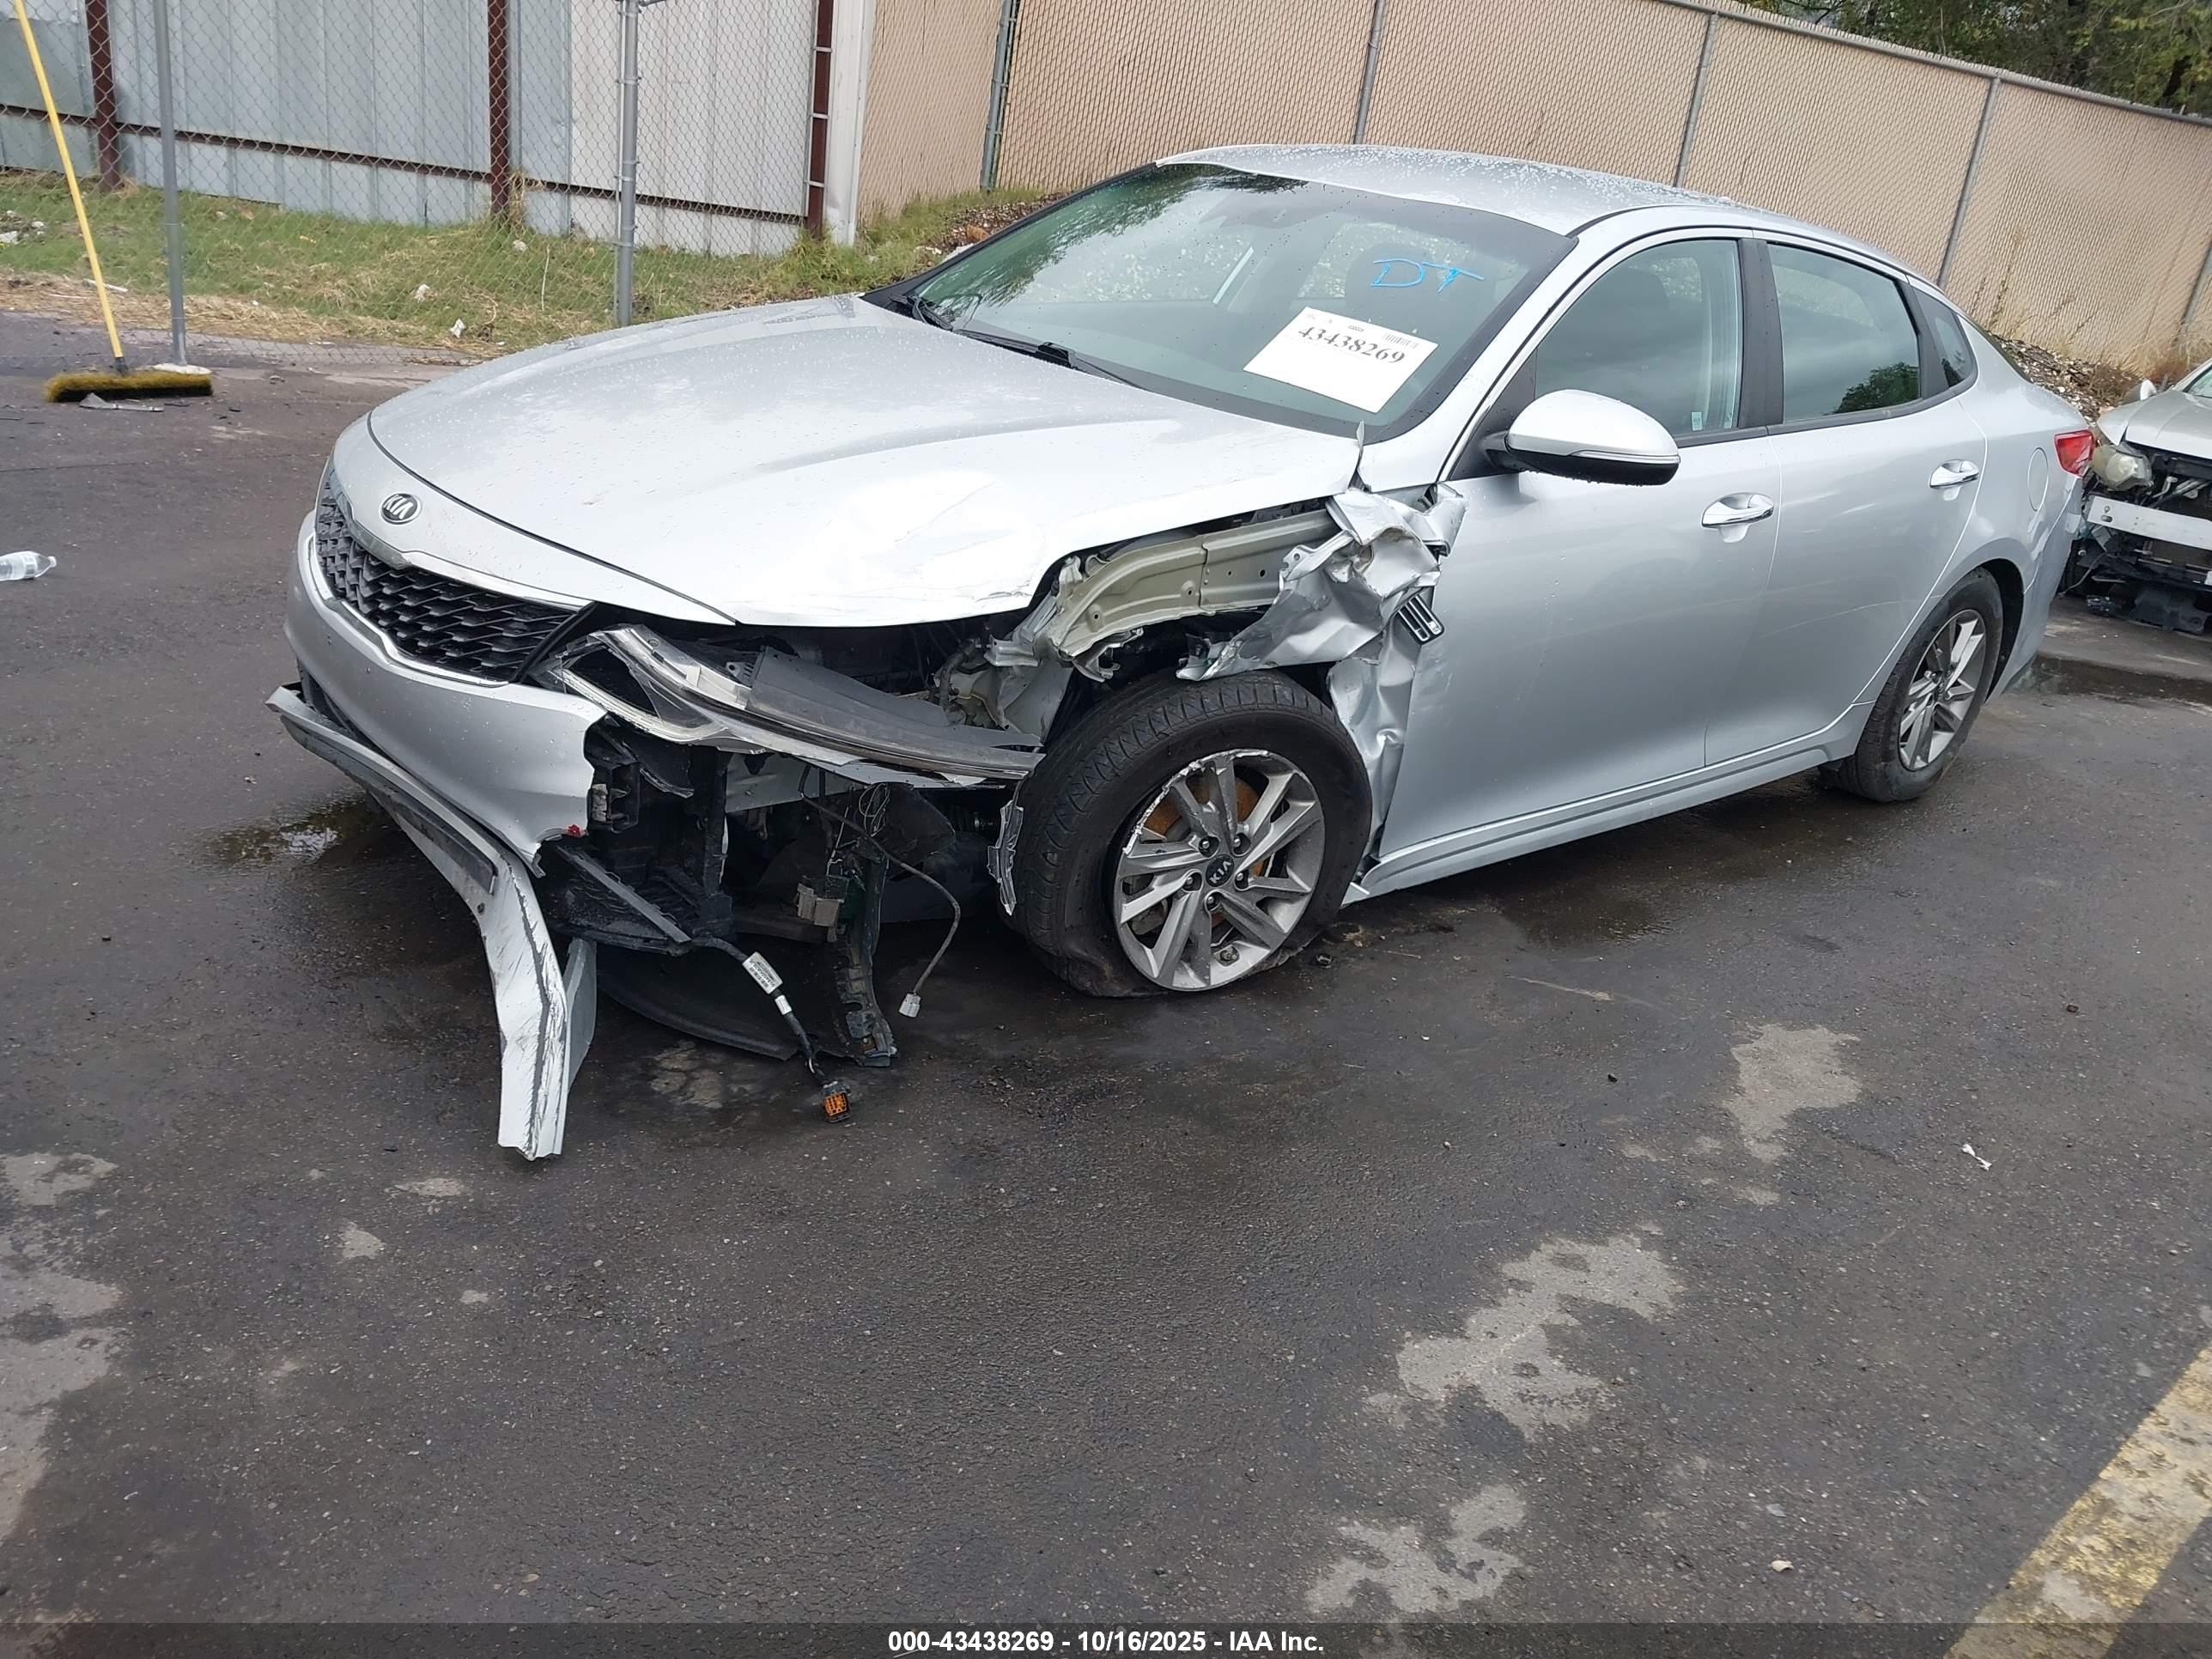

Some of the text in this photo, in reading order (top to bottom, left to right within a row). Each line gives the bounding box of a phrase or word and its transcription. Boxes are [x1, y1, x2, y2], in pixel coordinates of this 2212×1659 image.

[1298, 326, 1405, 363] 43438269
[383, 494, 414, 520] KIA
[1209, 860, 1231, 884] KIA
